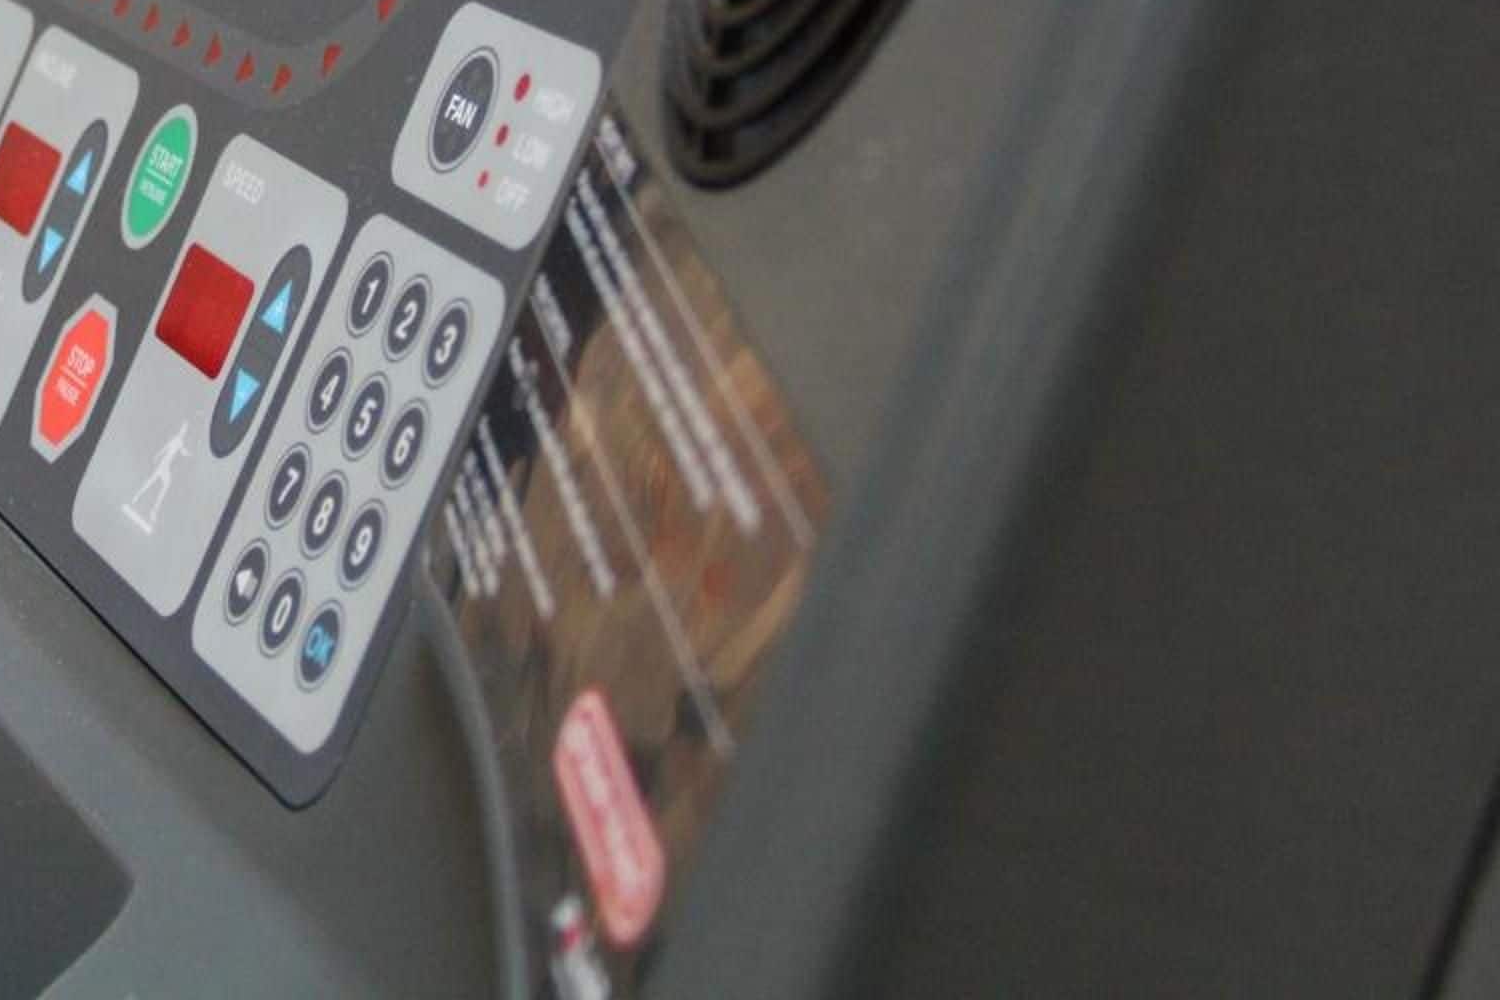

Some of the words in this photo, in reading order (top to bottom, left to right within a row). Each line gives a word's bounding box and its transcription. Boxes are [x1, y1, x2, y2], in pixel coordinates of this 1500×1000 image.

[444, 93, 479, 129] FAN
[148, 142, 184, 178] START
[220, 159, 266, 205] SPEED
[496, 176, 530, 210] OFF
[362, 279, 380, 314] 1
[394, 301, 417, 339] 2
[65, 346, 96, 378] STOP
[434, 325, 457, 364] 3
[320, 376, 340, 411] 4
[354, 399, 376, 437] 5
[392, 426, 414, 464] 6
[278, 467, 300, 505] 7
[312, 497, 334, 535] 8
[350, 526, 373, 566] 9
[271, 594, 293, 633] 0
[302, 623, 334, 665] OK
